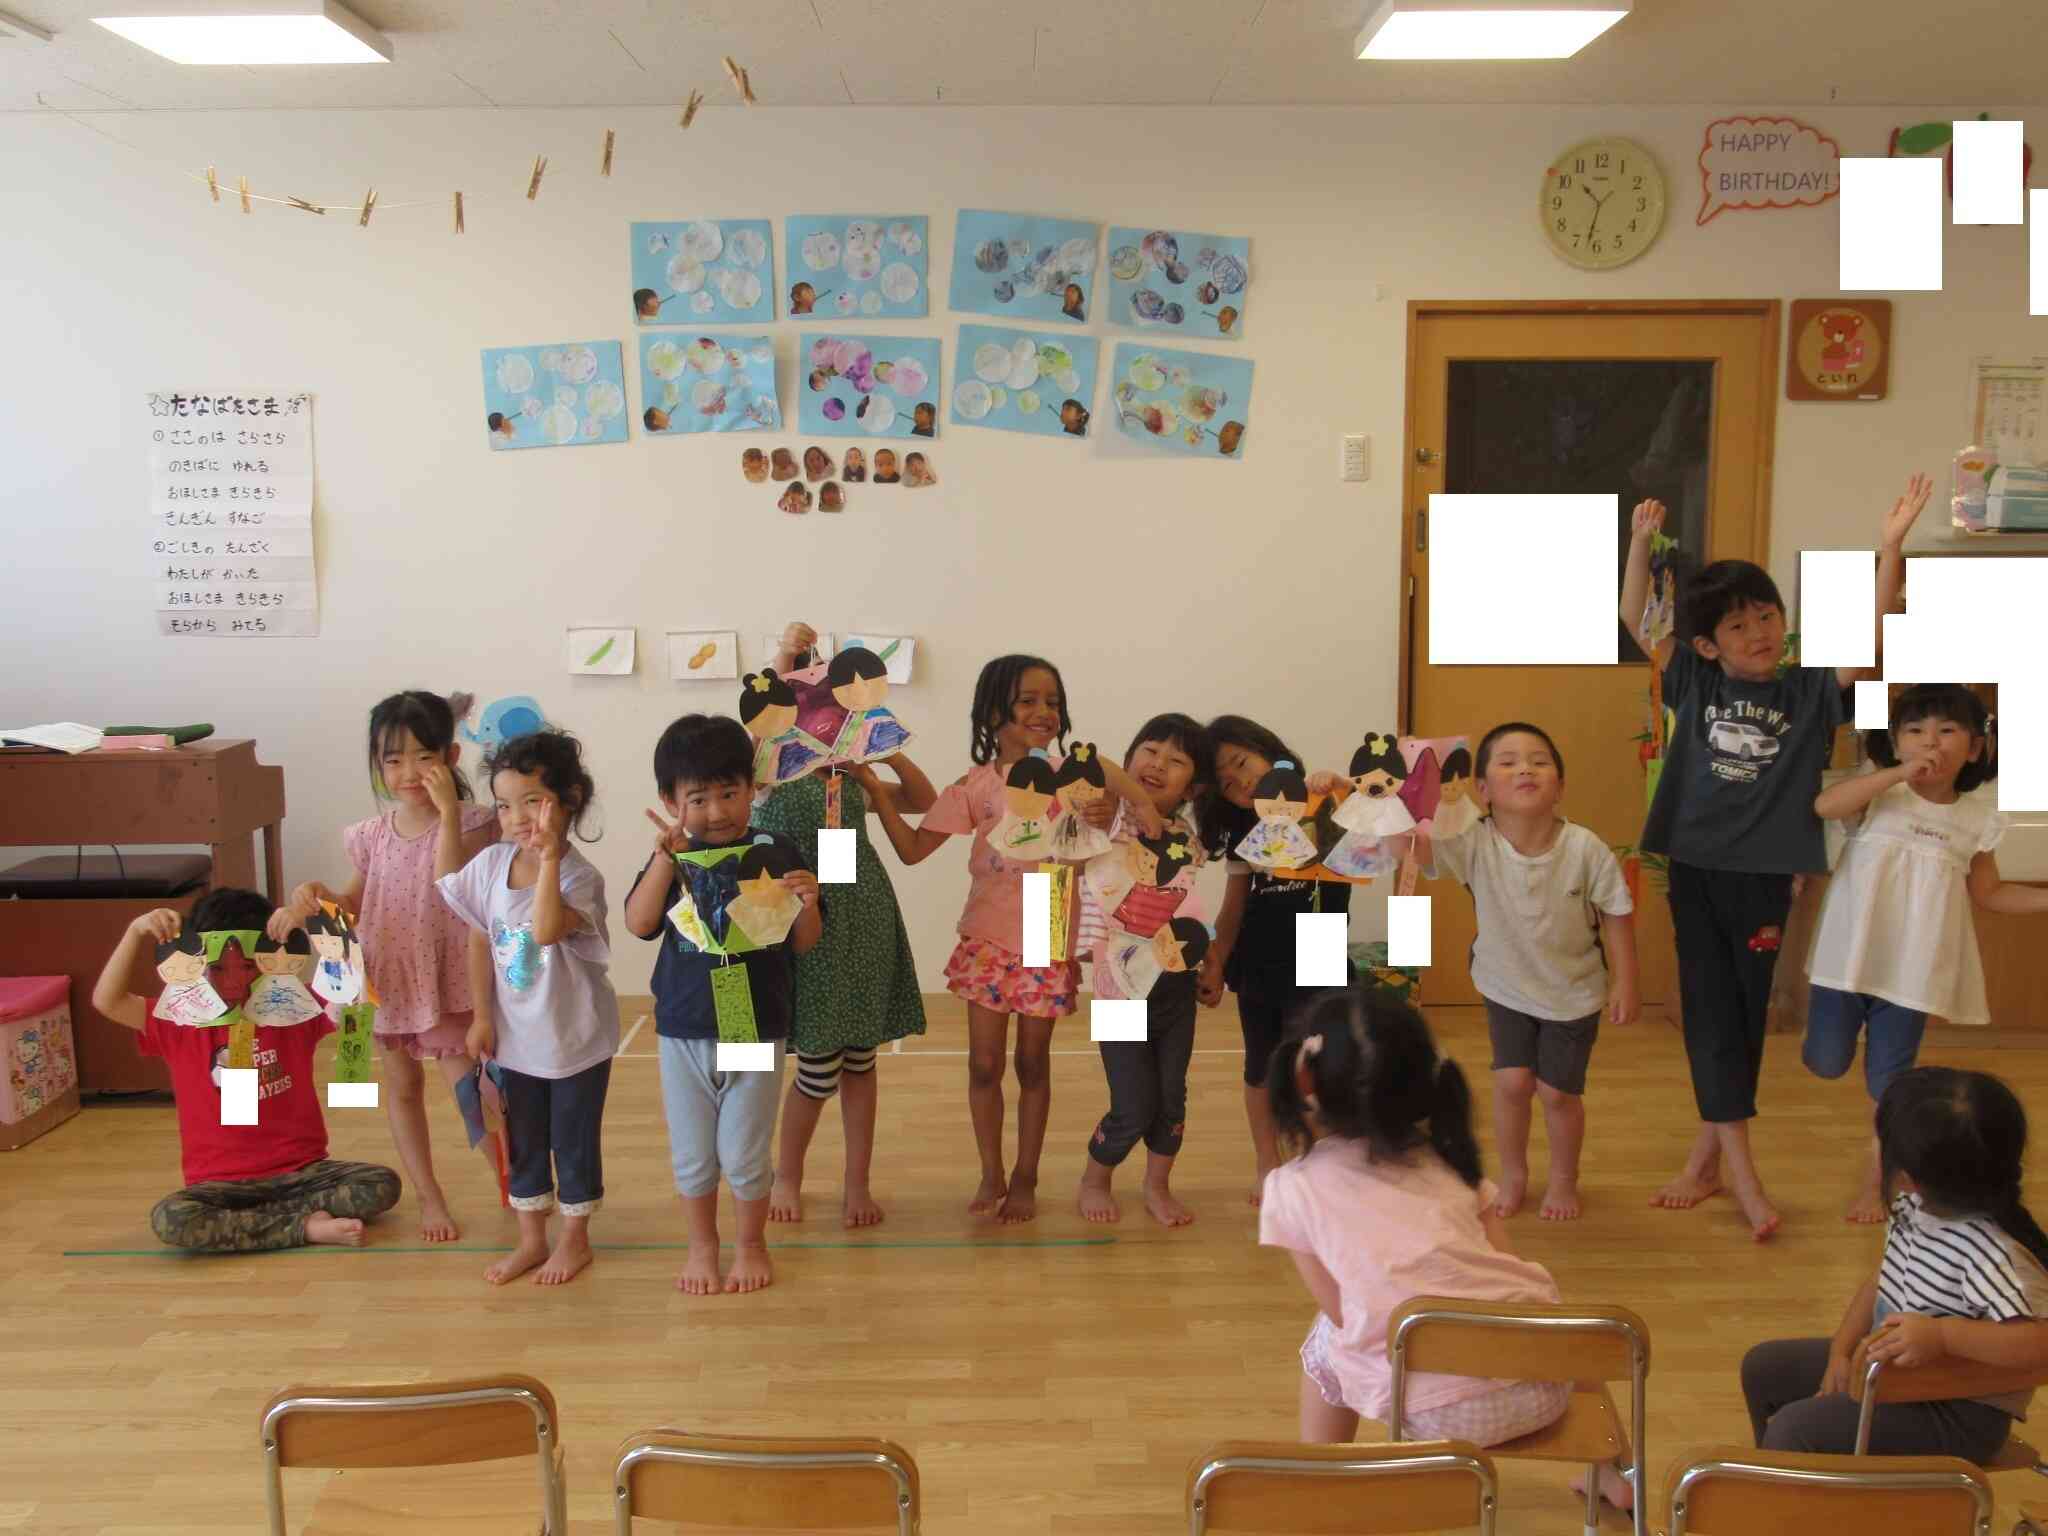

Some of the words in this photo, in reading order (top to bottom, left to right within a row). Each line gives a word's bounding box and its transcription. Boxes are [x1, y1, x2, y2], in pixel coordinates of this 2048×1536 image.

[1721, 133, 1792, 152] HAPPY
[1575, 158, 1584, 173] 11
[1595, 153, 1608, 168] 12
[1558, 174, 1572, 189] 10
[1632, 176, 1642, 192] 2
[1720, 172, 1829, 192] BIRTHDAY!
[1552, 196, 1562, 210] 9
[1636, 197, 1646, 212] 3
[1557, 218, 1566, 232] 8
[1628, 219, 1636, 232] 4
[1573, 234, 1580, 248] 7
[1592, 240, 1601, 253] 6
[1613, 235, 1622, 248] 5
[170, 394, 280, 417] たなばたさま
[166, 511, 216, 526] きんぎん
[1733, 700, 1765, 720] The
[253, 1049, 277, 1068] PER
